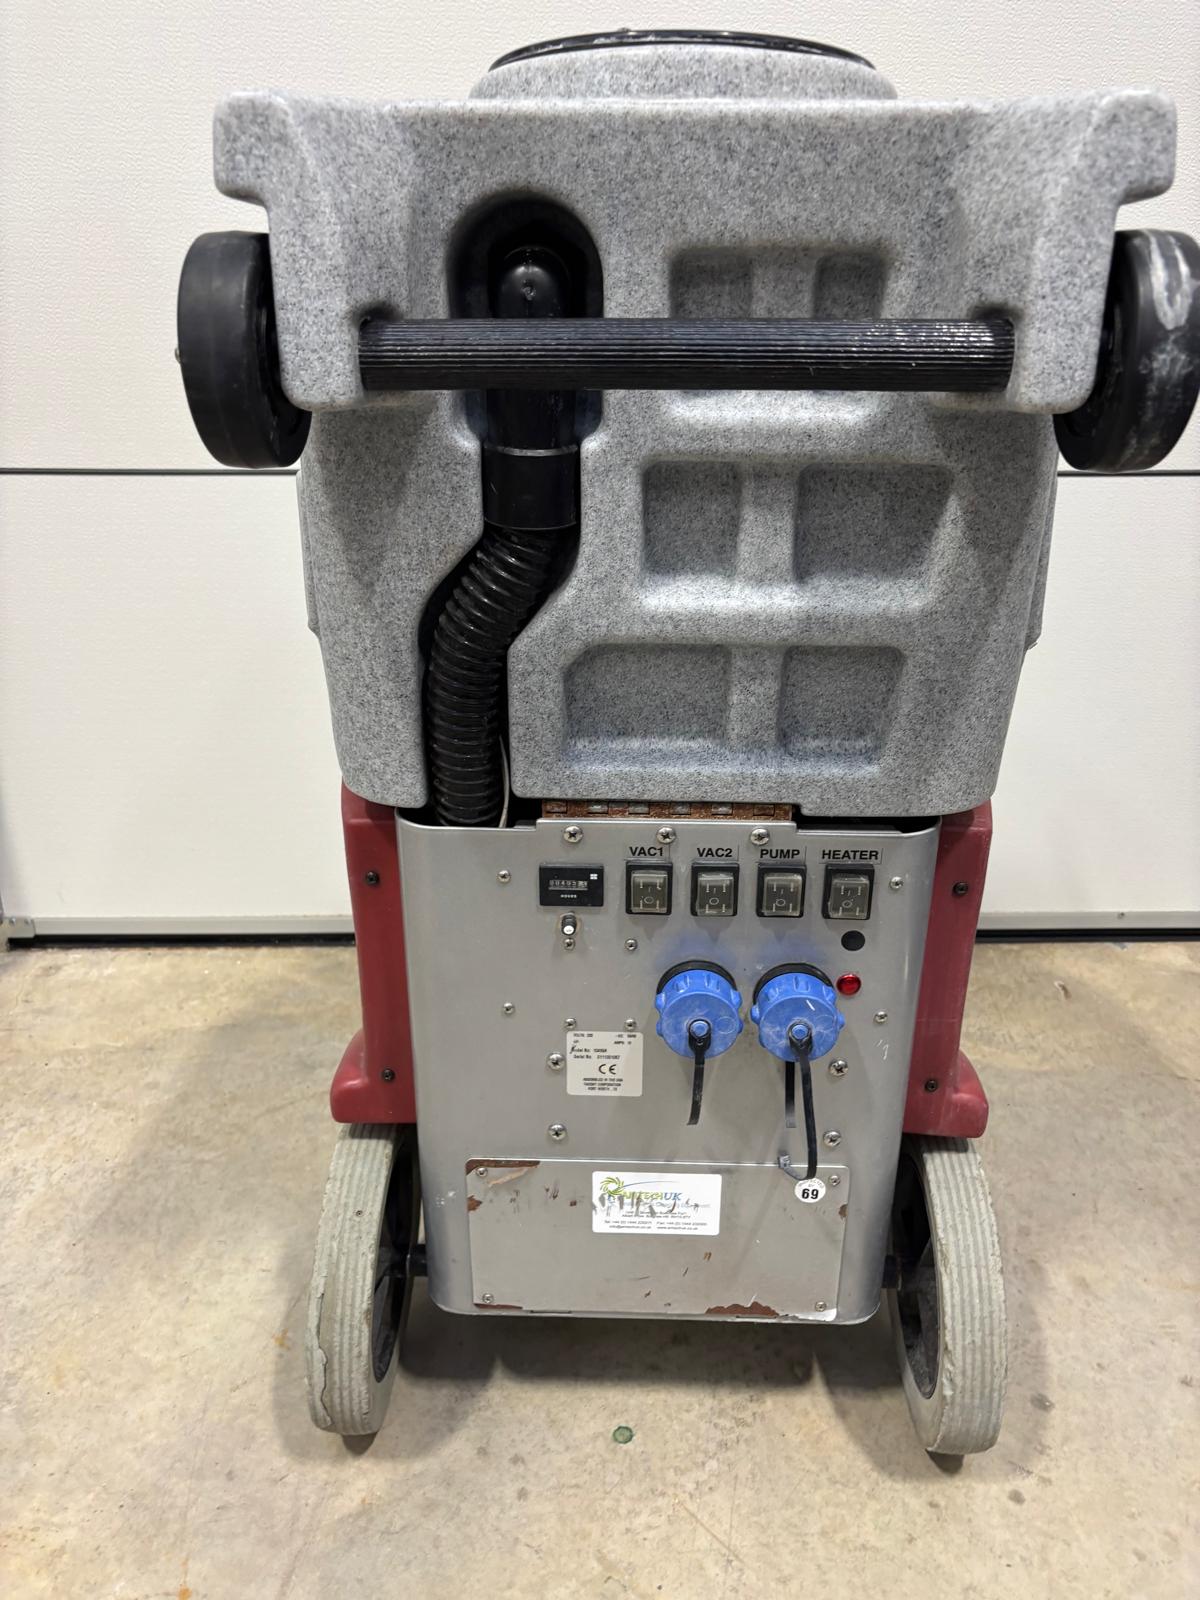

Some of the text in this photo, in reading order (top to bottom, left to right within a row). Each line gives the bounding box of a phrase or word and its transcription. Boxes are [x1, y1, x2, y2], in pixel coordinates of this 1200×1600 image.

[629, 846, 664, 857] VAC1
[697, 847, 733, 858] VAC2
[760, 848, 800, 859] PUMP
[821, 849, 879, 860] HEATER
[801, 1188, 819, 1200] 69
